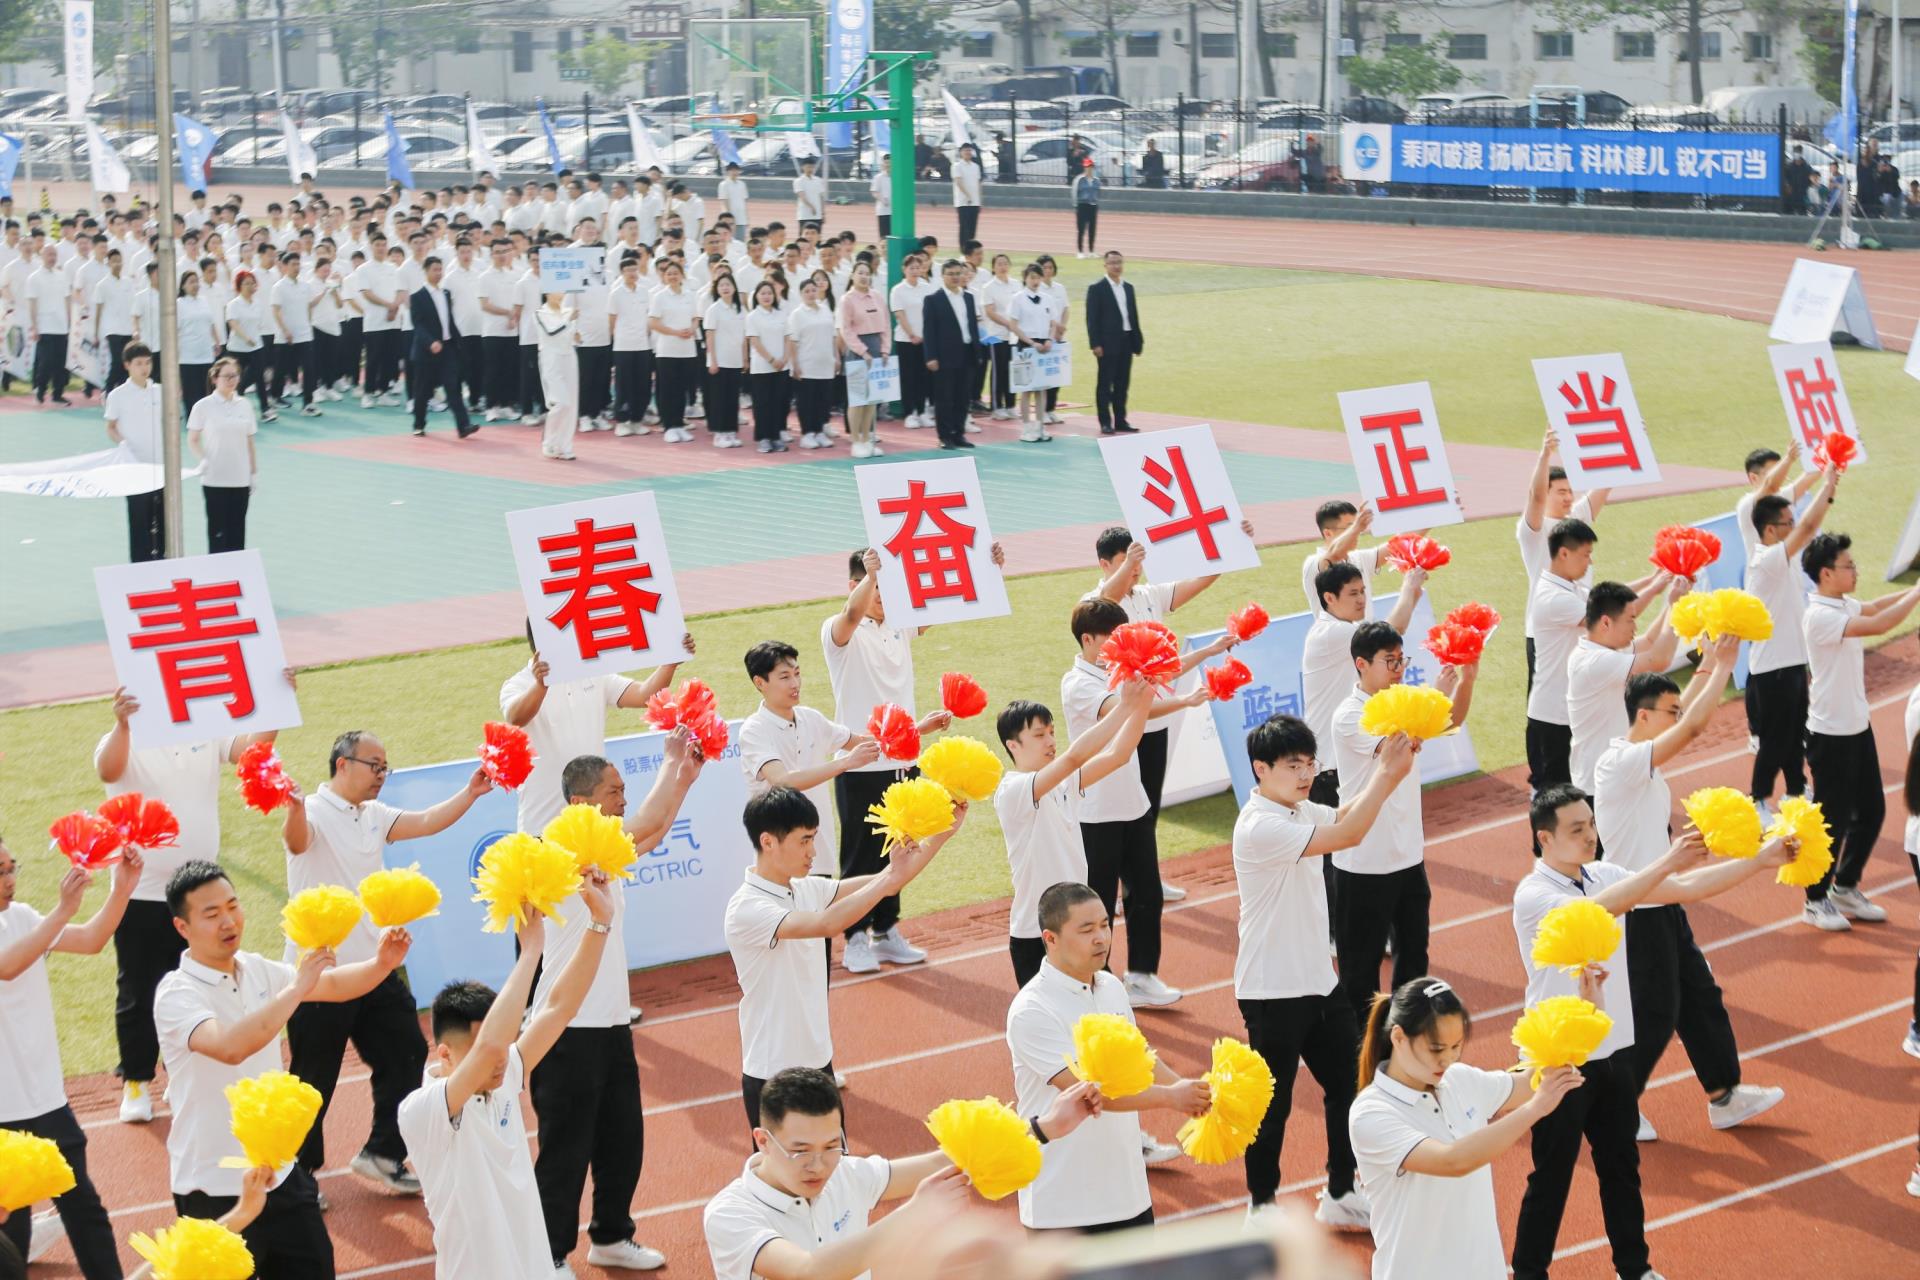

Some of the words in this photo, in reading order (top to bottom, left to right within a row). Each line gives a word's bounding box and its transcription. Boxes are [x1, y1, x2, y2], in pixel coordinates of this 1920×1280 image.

[1401, 139, 1483, 170] 乘风破浪
[1488, 142, 1574, 172] 扬帆远航
[1579, 144, 1669, 175] 科林健儿
[1675, 147, 1767, 179] 锐不可当
[1557, 371, 1642, 472] 当
[1784, 356, 1846, 449] 时
[1141, 445, 1229, 561] 斗
[1360, 408, 1448, 512] 正
[537, 517, 662, 660] 春
[878, 480, 978, 610] 奋
[126, 578, 259, 724] 青
[623, 858, 703, 888] ECTRIC
